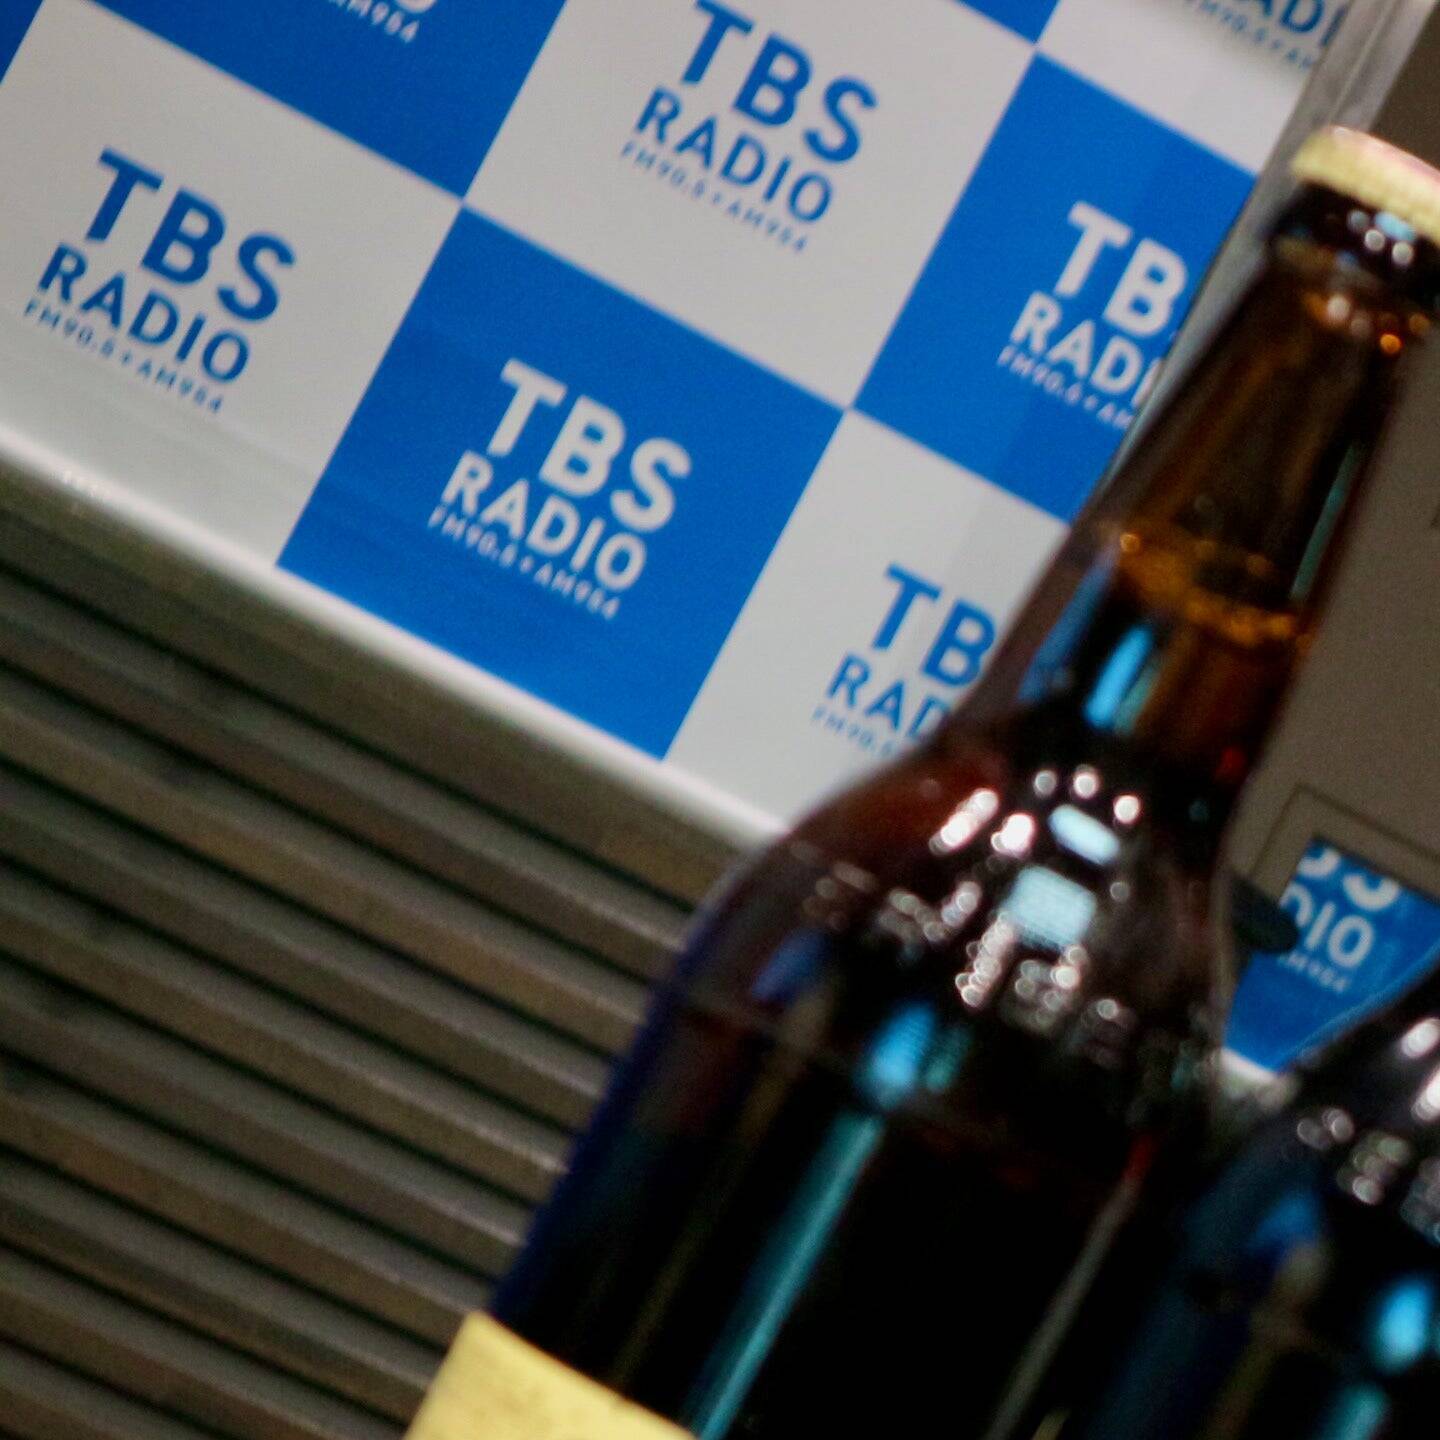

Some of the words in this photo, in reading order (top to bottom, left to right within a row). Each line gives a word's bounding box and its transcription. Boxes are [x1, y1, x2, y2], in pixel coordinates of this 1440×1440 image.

[682, 0, 877, 164] TBS
[635, 86, 832, 223] RADIO
[86, 147, 296, 321] TBS
[1053, 201, 1189, 338] TB
[38, 242, 250, 383] RADIO
[1009, 290, 1164, 409] RADI
[486, 357, 692, 532] TBS
[441, 450, 648, 591] RADIO
[872, 562, 999, 689] TB
